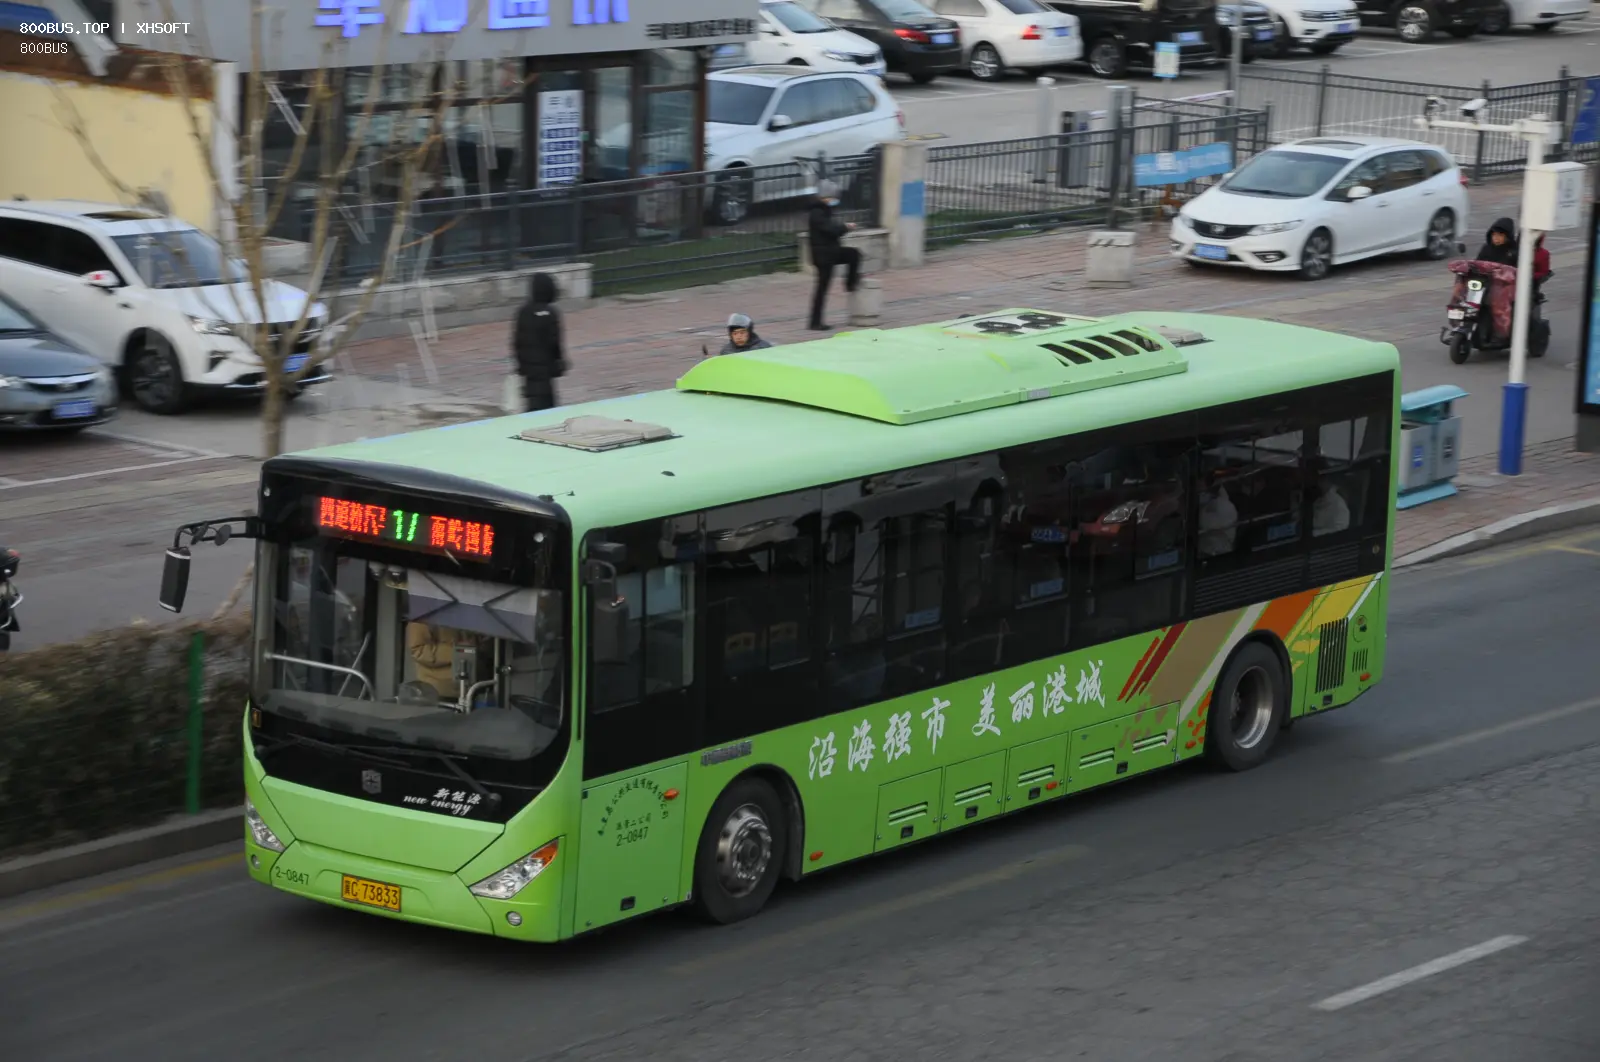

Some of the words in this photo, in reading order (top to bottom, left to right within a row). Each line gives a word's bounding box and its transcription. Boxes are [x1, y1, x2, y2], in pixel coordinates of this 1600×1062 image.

[972, 659, 1106, 736] 美丽港城
[808, 697, 951, 780] 沿海强市
[403, 795, 428, 805] new
[430, 799, 474, 816] energy
[433, 787, 482, 805] 新能源
[616, 826, 649, 847] 2-0847
[275, 866, 309, 885] 2-0847
